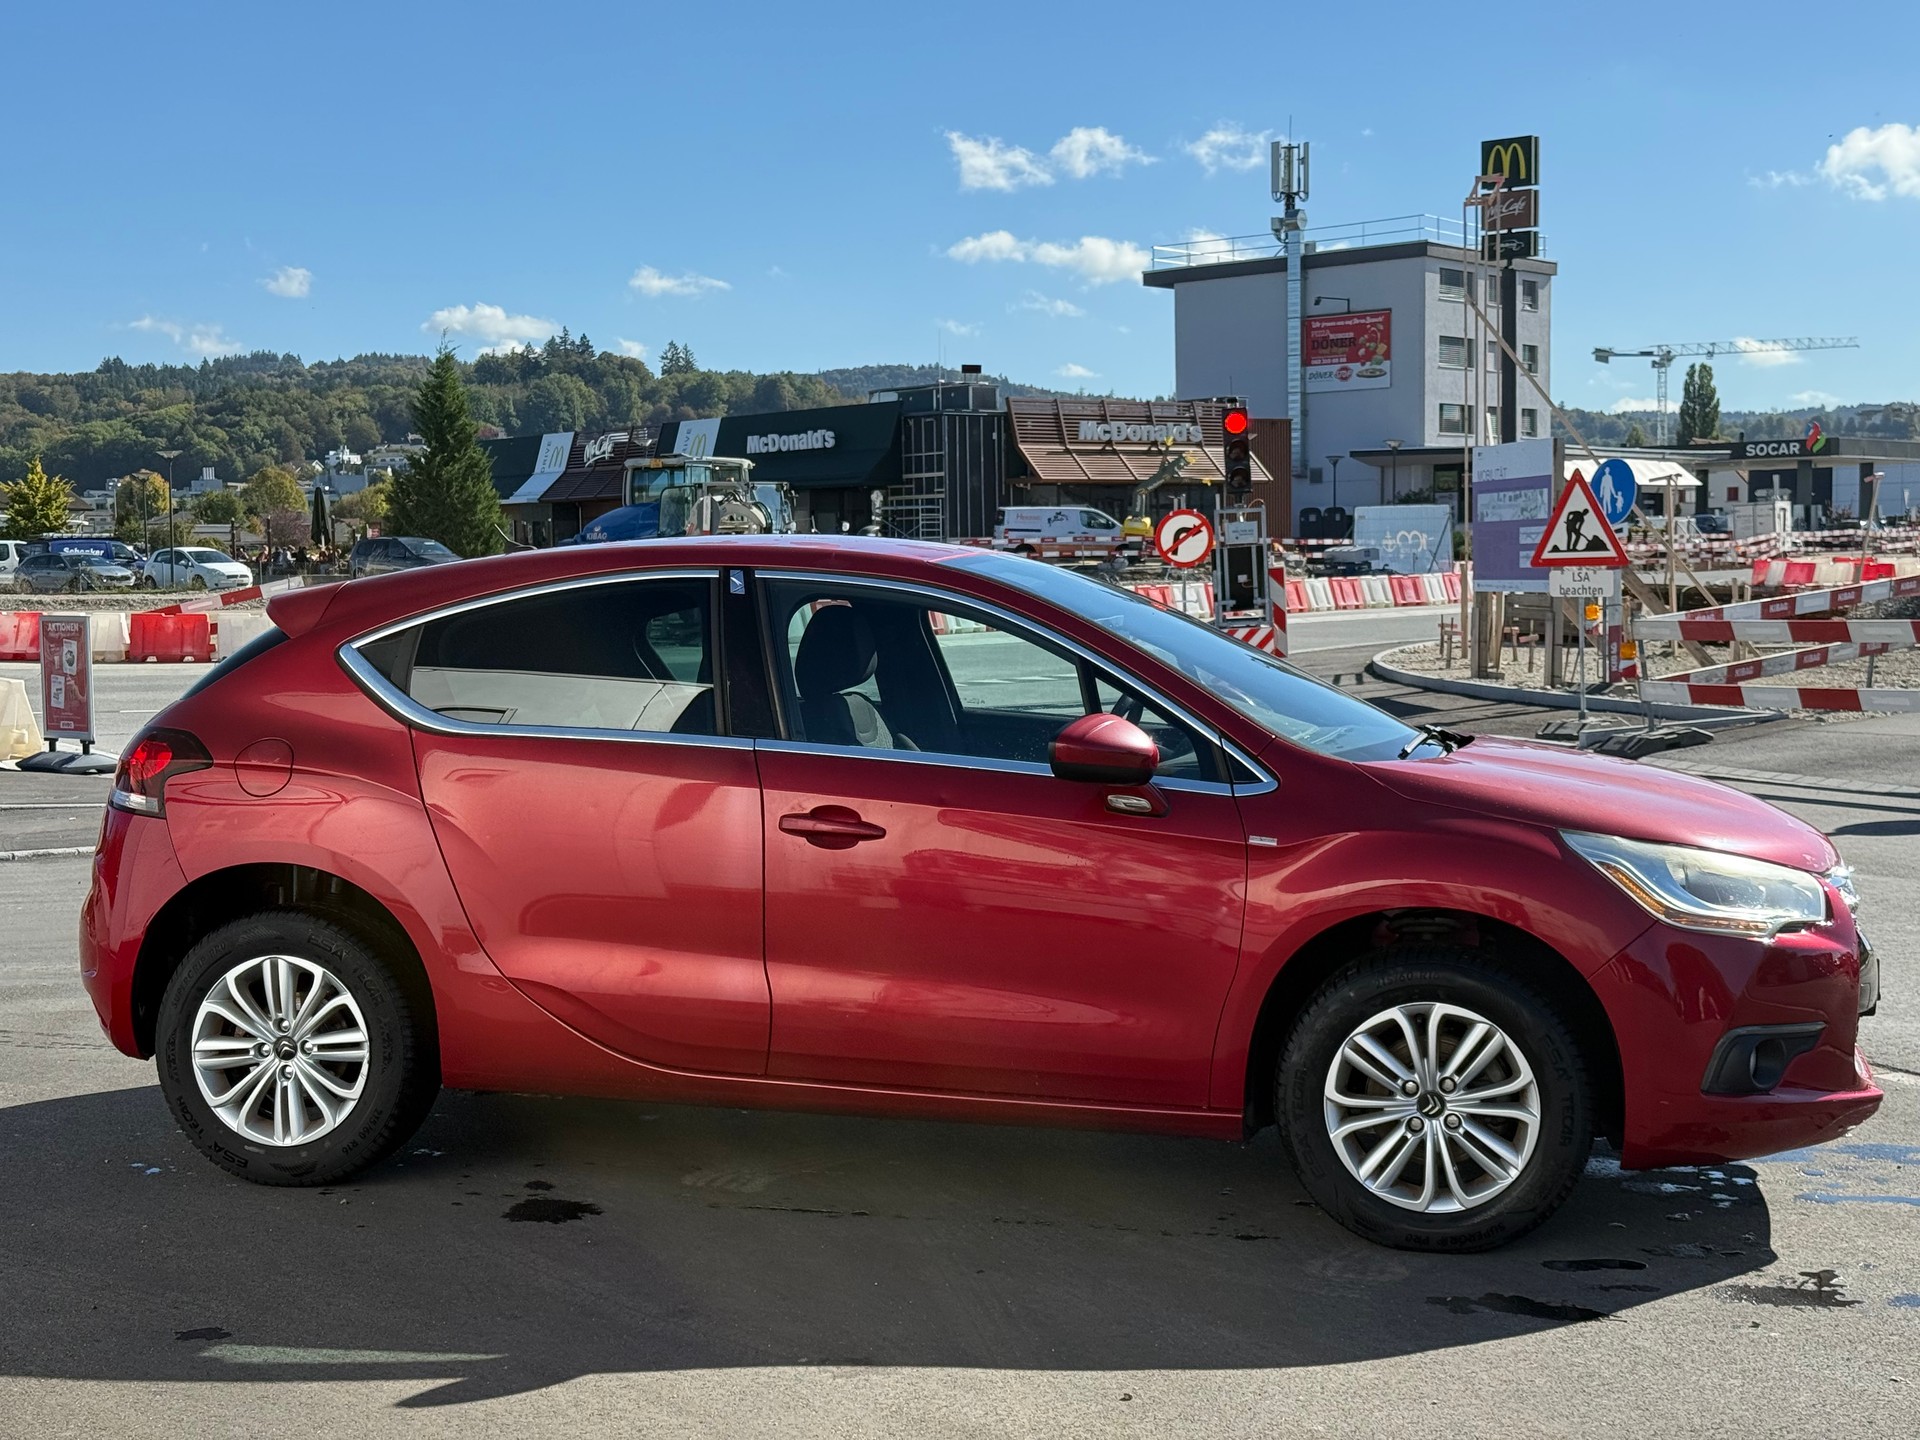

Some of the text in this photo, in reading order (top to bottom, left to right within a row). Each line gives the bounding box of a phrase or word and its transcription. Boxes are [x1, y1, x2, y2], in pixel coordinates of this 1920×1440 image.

[1077, 420, 1203, 443] McDonald's
[746, 429, 836, 454] McDonald's
[1745, 442, 1800, 456] SOCAR
[540, 440, 552, 473] DRIVE
[1572, 572, 1591, 582] LSA
[1559, 584, 1604, 596] beachten
[48, 623, 79, 632] AKTIONEN
